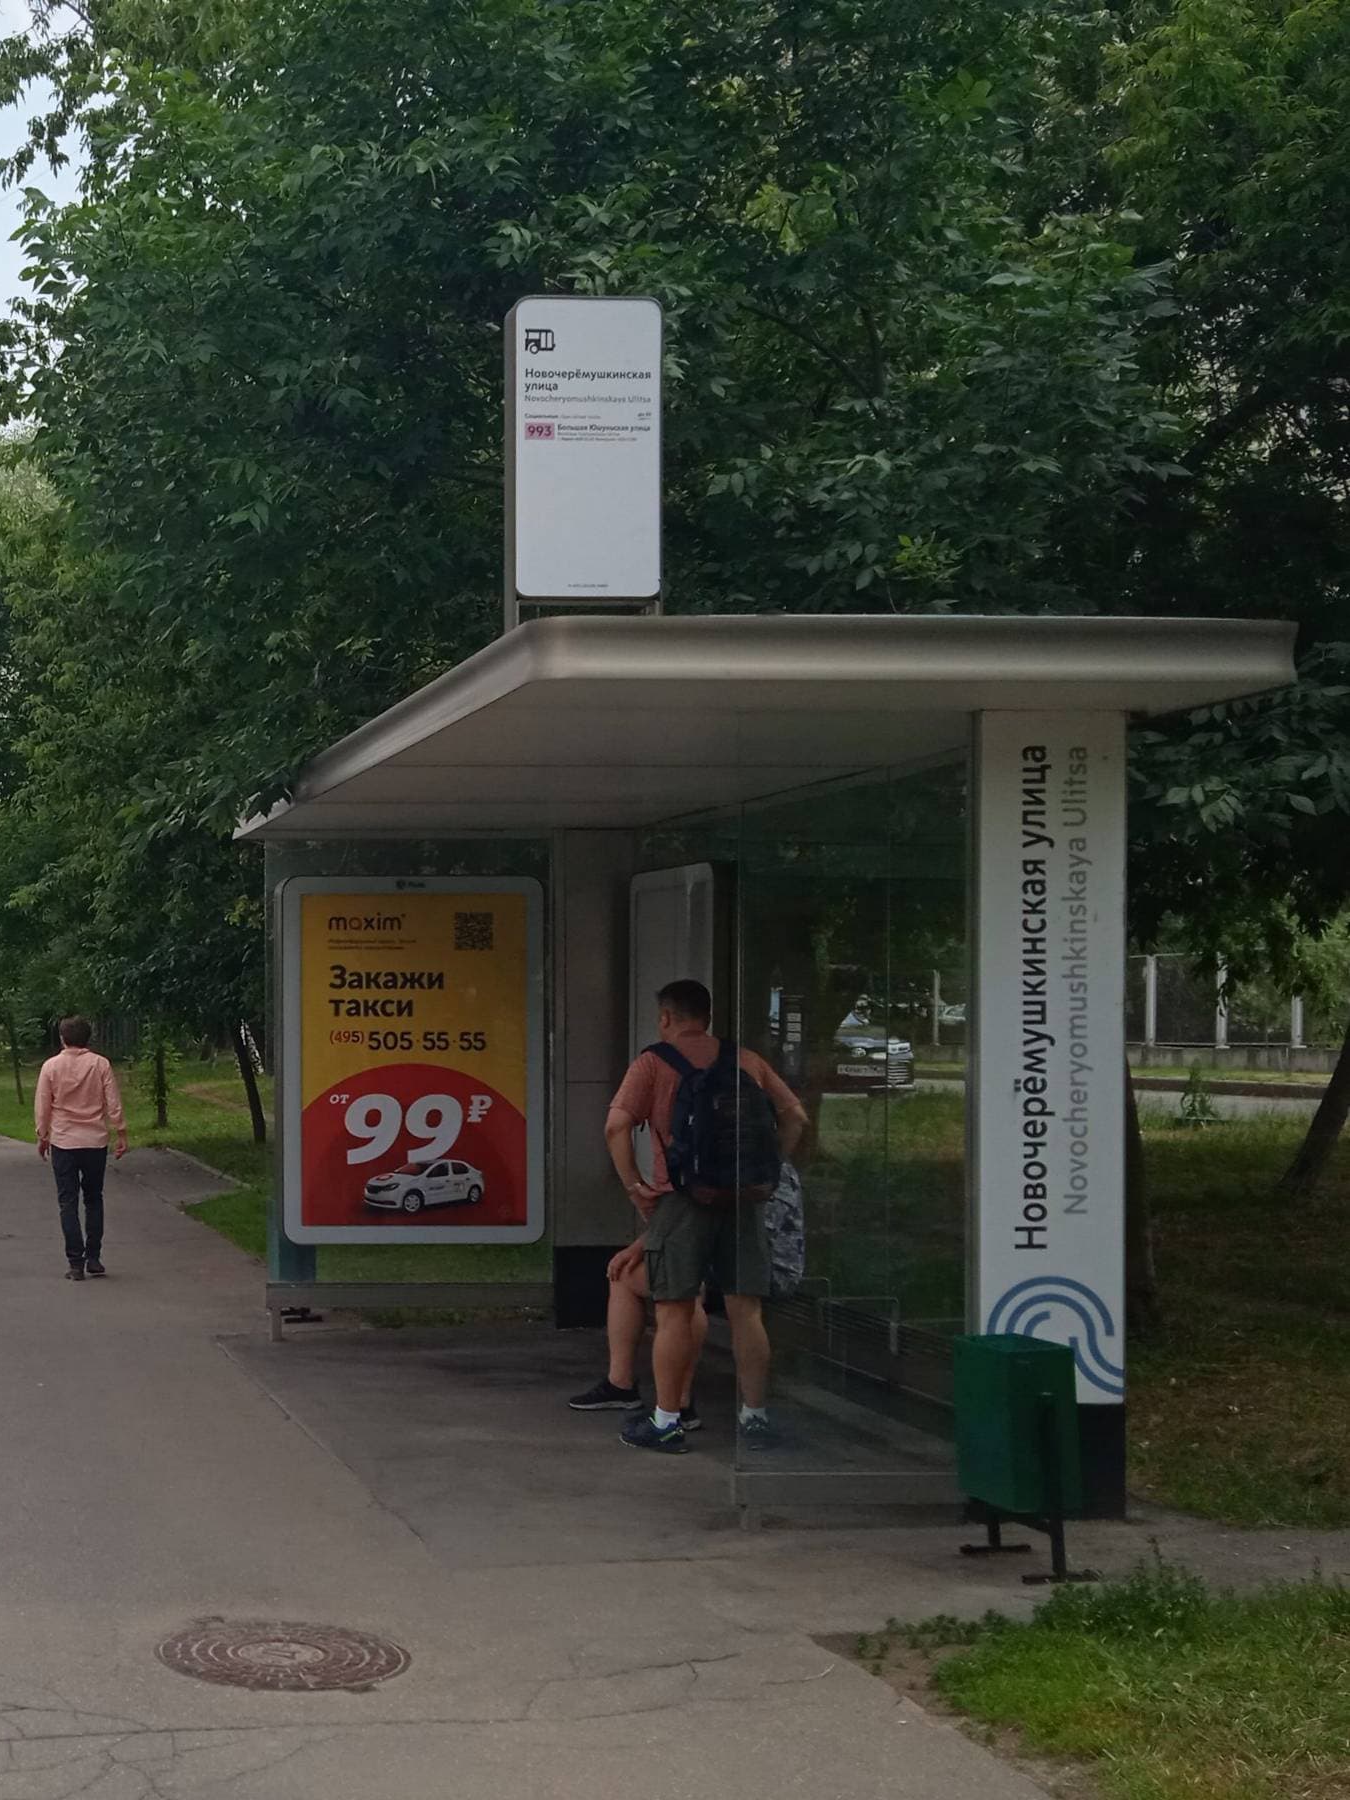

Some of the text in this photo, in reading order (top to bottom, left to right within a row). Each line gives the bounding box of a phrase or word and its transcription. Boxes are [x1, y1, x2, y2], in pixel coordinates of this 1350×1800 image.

[525, 368, 651, 381] Новочерёмушкинская
[525, 382, 559, 392] улица
[528, 425, 552, 437] 993
[329, 912, 402, 931] maxim
[329, 965, 444, 990] Закажи
[1062, 746, 1093, 1215] Novocheryomushkinskaya Ulitsa
[1014, 745, 1055, 1250] Новочерёмушкинская улица
[329, 999, 413, 1018] такси
[329, 1030, 365, 1045] (495)
[344, 1093, 463, 1165] 99
